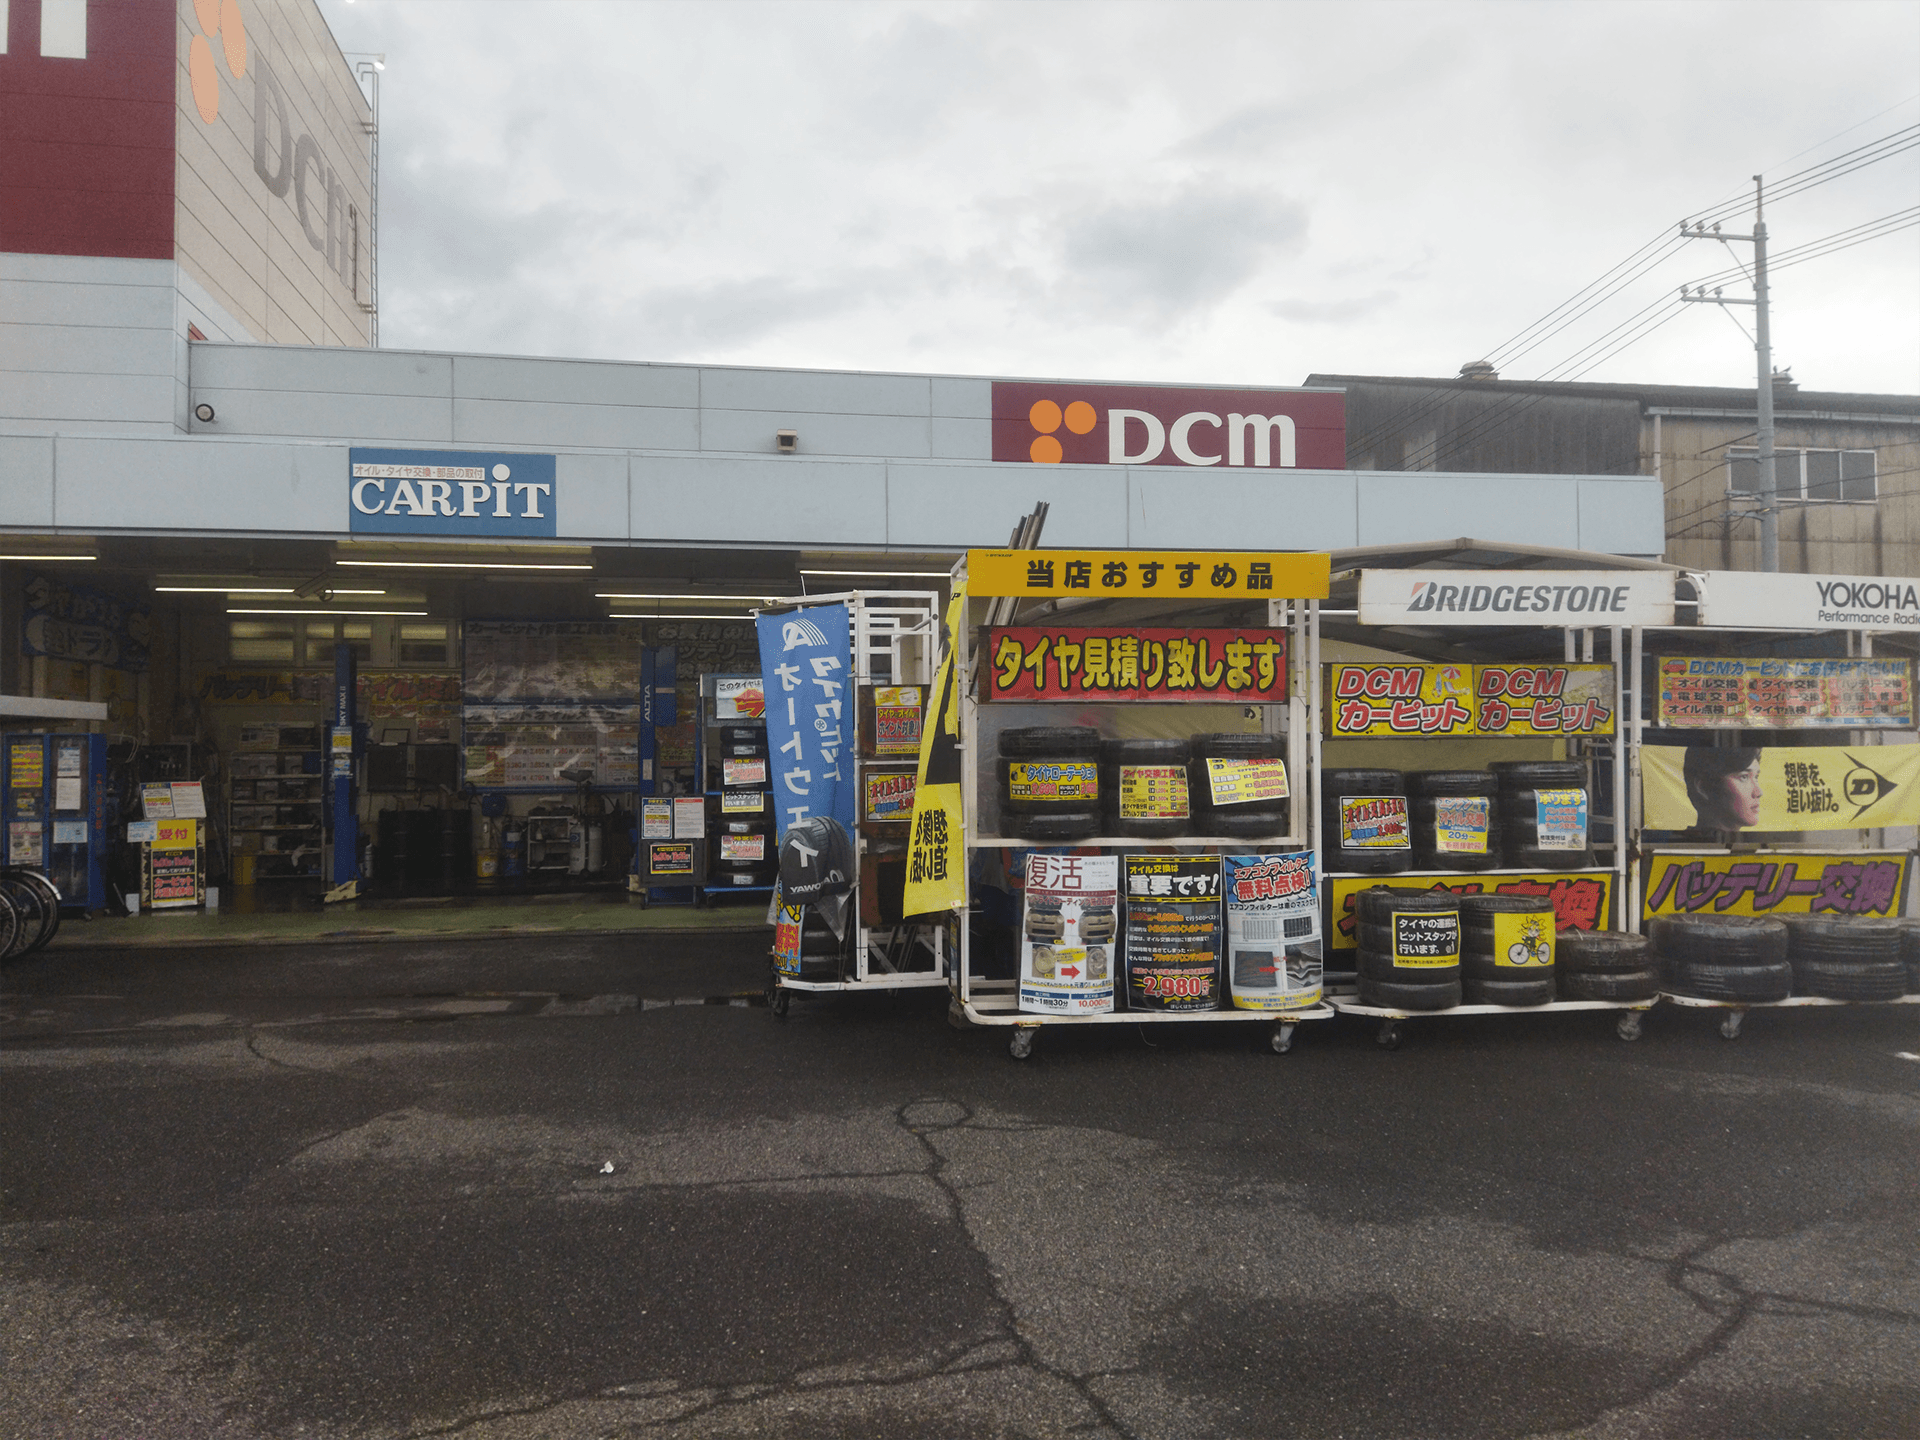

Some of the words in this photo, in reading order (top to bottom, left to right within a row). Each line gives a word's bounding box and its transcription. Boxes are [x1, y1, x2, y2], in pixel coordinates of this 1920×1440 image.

[355, 464, 484, 480] オイル・タイヤ交換・部品の取付
[1026, 559, 1273, 589] 当店おすすめ品
[1406, 581, 1630, 612] BRIDGESTONE
[1818, 610, 1890, 624] Performance
[995, 636, 1281, 692] タイヤ見積り致します
[1337, 667, 1422, 697] DCM
[1479, 668, 1567, 697] DCM
[1678, 679, 1738, 689] オイル交換
[1762, 679, 1819, 690] タイヤ交換
[1678, 691, 1738, 702] 電球交換
[1337, 699, 1471, 731] カーピット
[1478, 698, 1610, 731] カーピット
[1668, 704, 1725, 715] オイル点検
[1027, 765, 1096, 781] タイヤローテーション
[1787, 789, 1839, 814] 追い抜け。
[1439, 812, 1486, 826] オイル交換
[158, 828, 188, 841] 受付
[1026, 855, 1083, 889] 復活
[1129, 864, 1179, 874] オイル交換は
[1233, 857, 1308, 880] エアコンフィルター
[1129, 873, 1219, 896] 重要です!
[1236, 869, 1311, 901] 無料点検!
[1647, 860, 1900, 915] バッテリー交換
[1399, 930, 1457, 942] ピットスタッフが
[1399, 943, 1440, 954] 行います。
